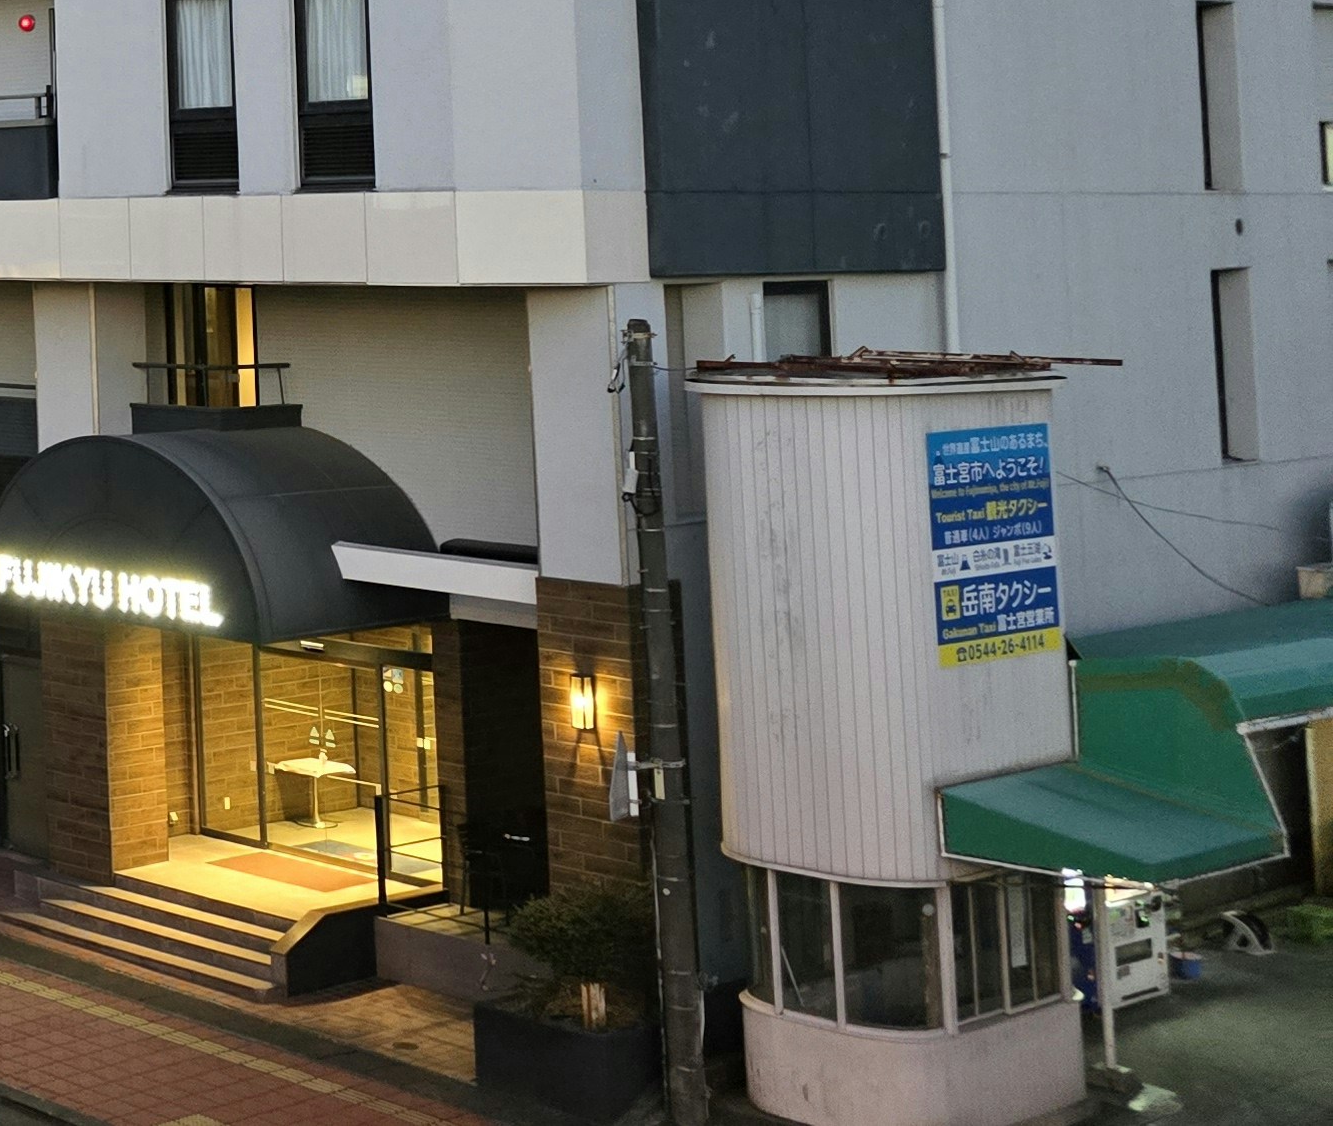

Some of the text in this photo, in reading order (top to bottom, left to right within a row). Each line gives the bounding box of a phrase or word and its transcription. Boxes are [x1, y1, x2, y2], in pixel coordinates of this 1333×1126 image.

[936, 510, 966, 523] Tourist
[967, 508, 985, 521] Taxi
[117, 571, 224, 627] HOTEL
[961, 580, 1052, 617] 岳南タクシー
